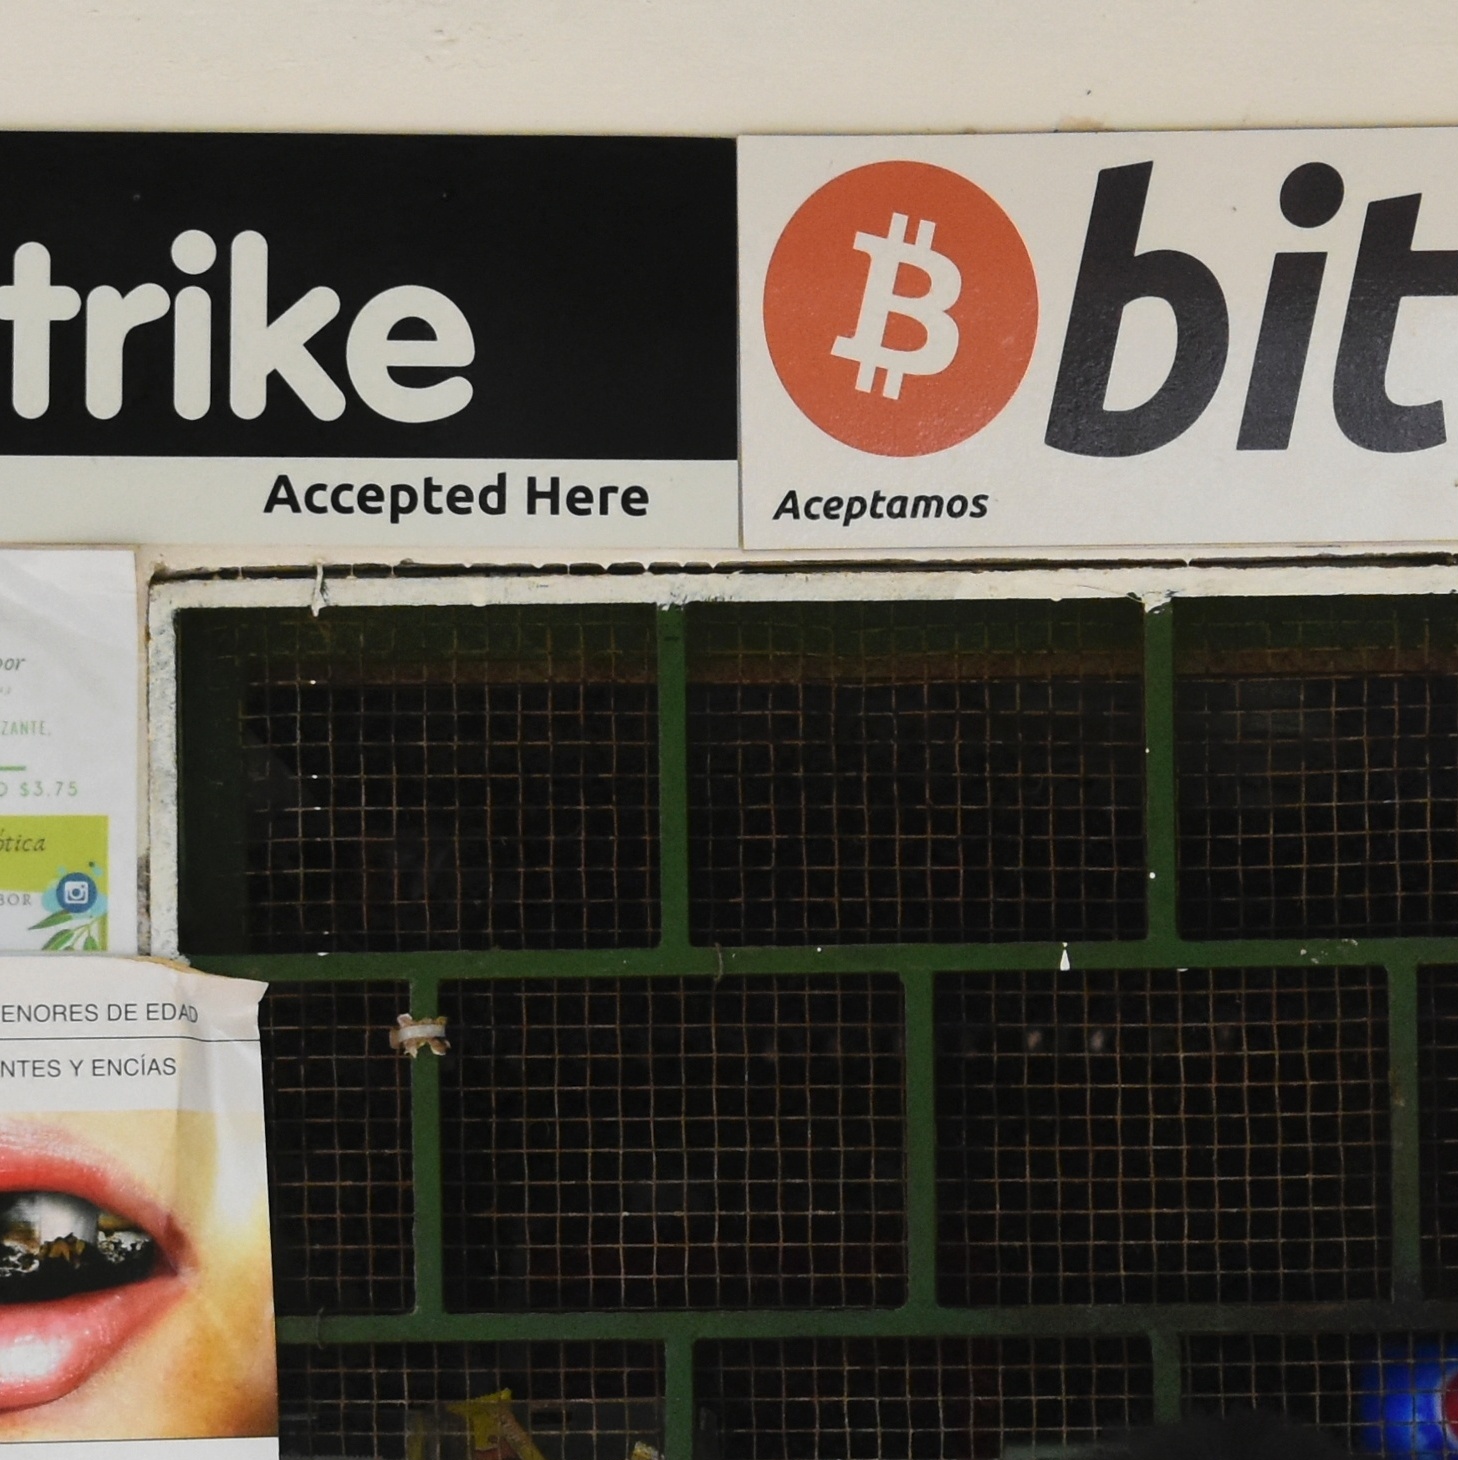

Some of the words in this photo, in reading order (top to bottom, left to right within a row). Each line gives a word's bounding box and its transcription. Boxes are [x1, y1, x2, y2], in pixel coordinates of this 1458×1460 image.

[263, 472, 507, 523] Accepted
[526, 476, 649, 516] Here
[773, 488, 988, 527] Aceptamos
[20, 780, 79, 798] $3.75
[107, 1003, 138, 1021] DE
[146, 1003, 199, 1023] EDAD
[69, 1059, 84, 1077] Y
[92, 1054, 177, 1077] ENCÍAS
